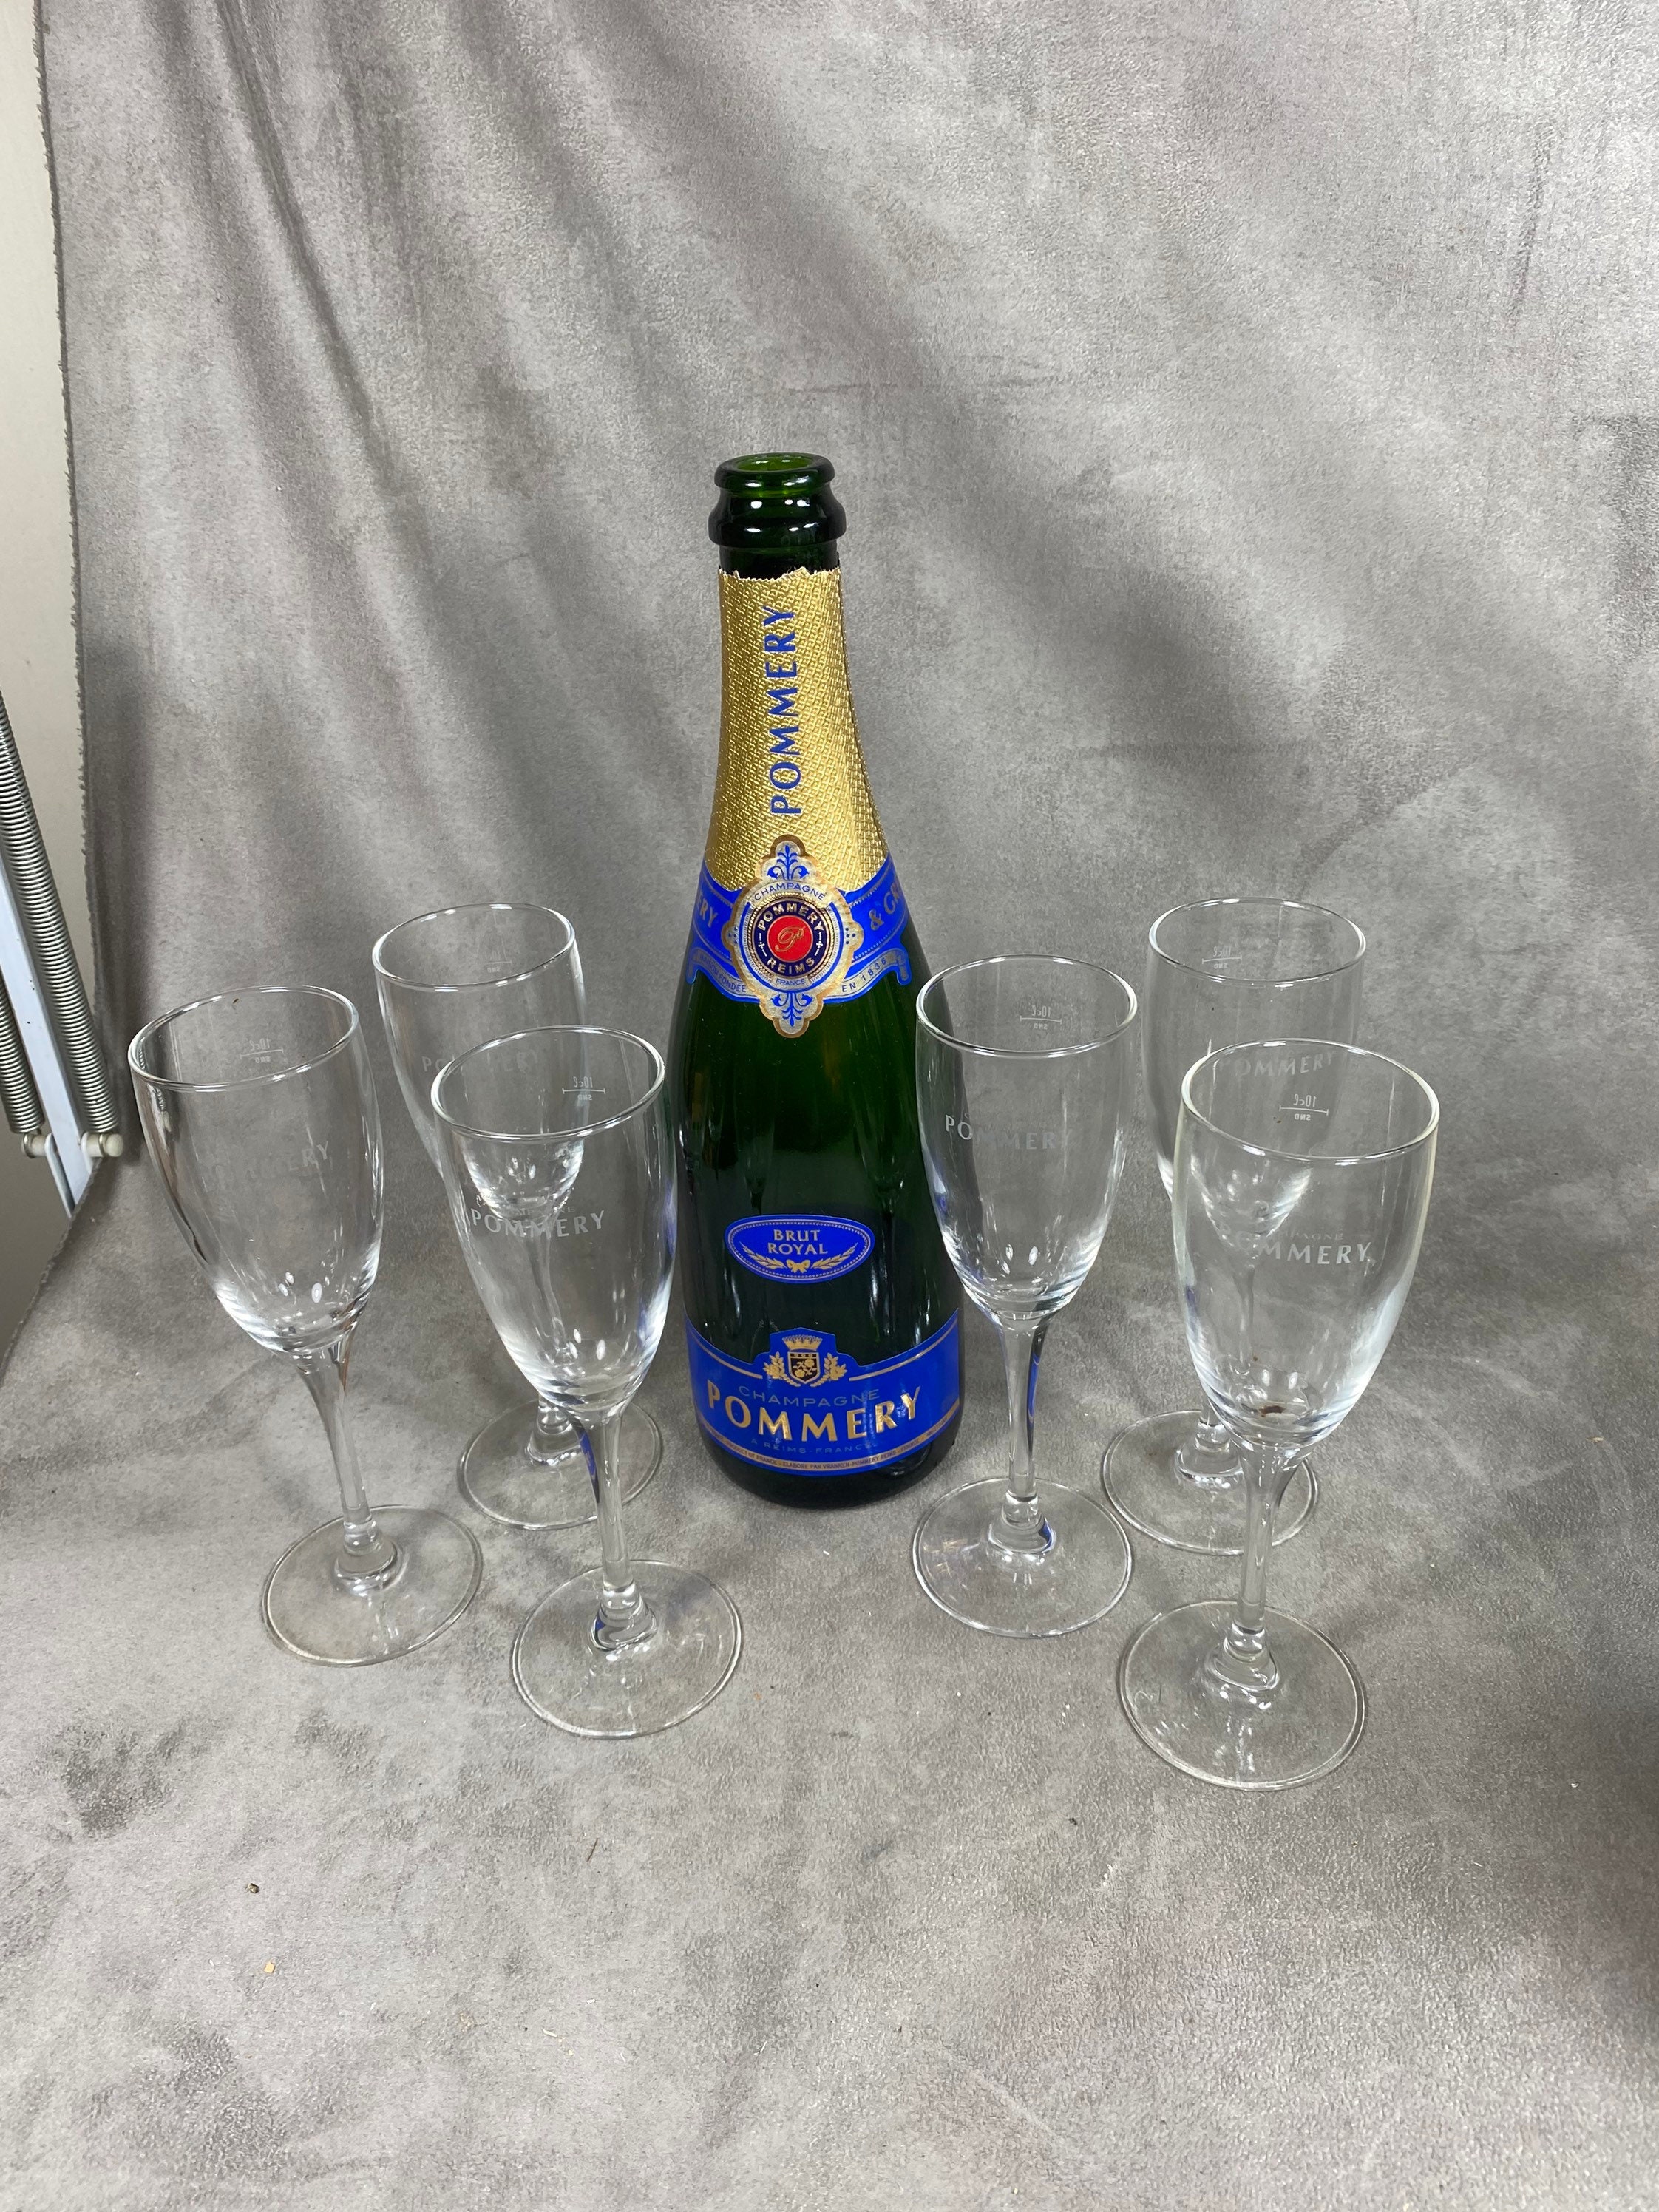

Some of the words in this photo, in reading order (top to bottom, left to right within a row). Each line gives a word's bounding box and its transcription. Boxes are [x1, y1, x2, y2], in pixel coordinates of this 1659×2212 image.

[761, 605, 801, 815] POMMERY
[754, 882, 827, 901] CHAMPAGNE
[757, 903, 825, 932] POMMERY
[767, 957, 815, 974] REIMS
[841, 982, 856, 993] EN
[861, 957, 887, 981] 1836
[776, 978, 807, 986] FRANCE
[773, 1229, 821, 1241] BRUT
[767, 1241, 828, 1255] ROYAL
[739, 1385, 881, 1408] CHAMPAGNE
[707, 1378, 920, 1442] POMMERY
